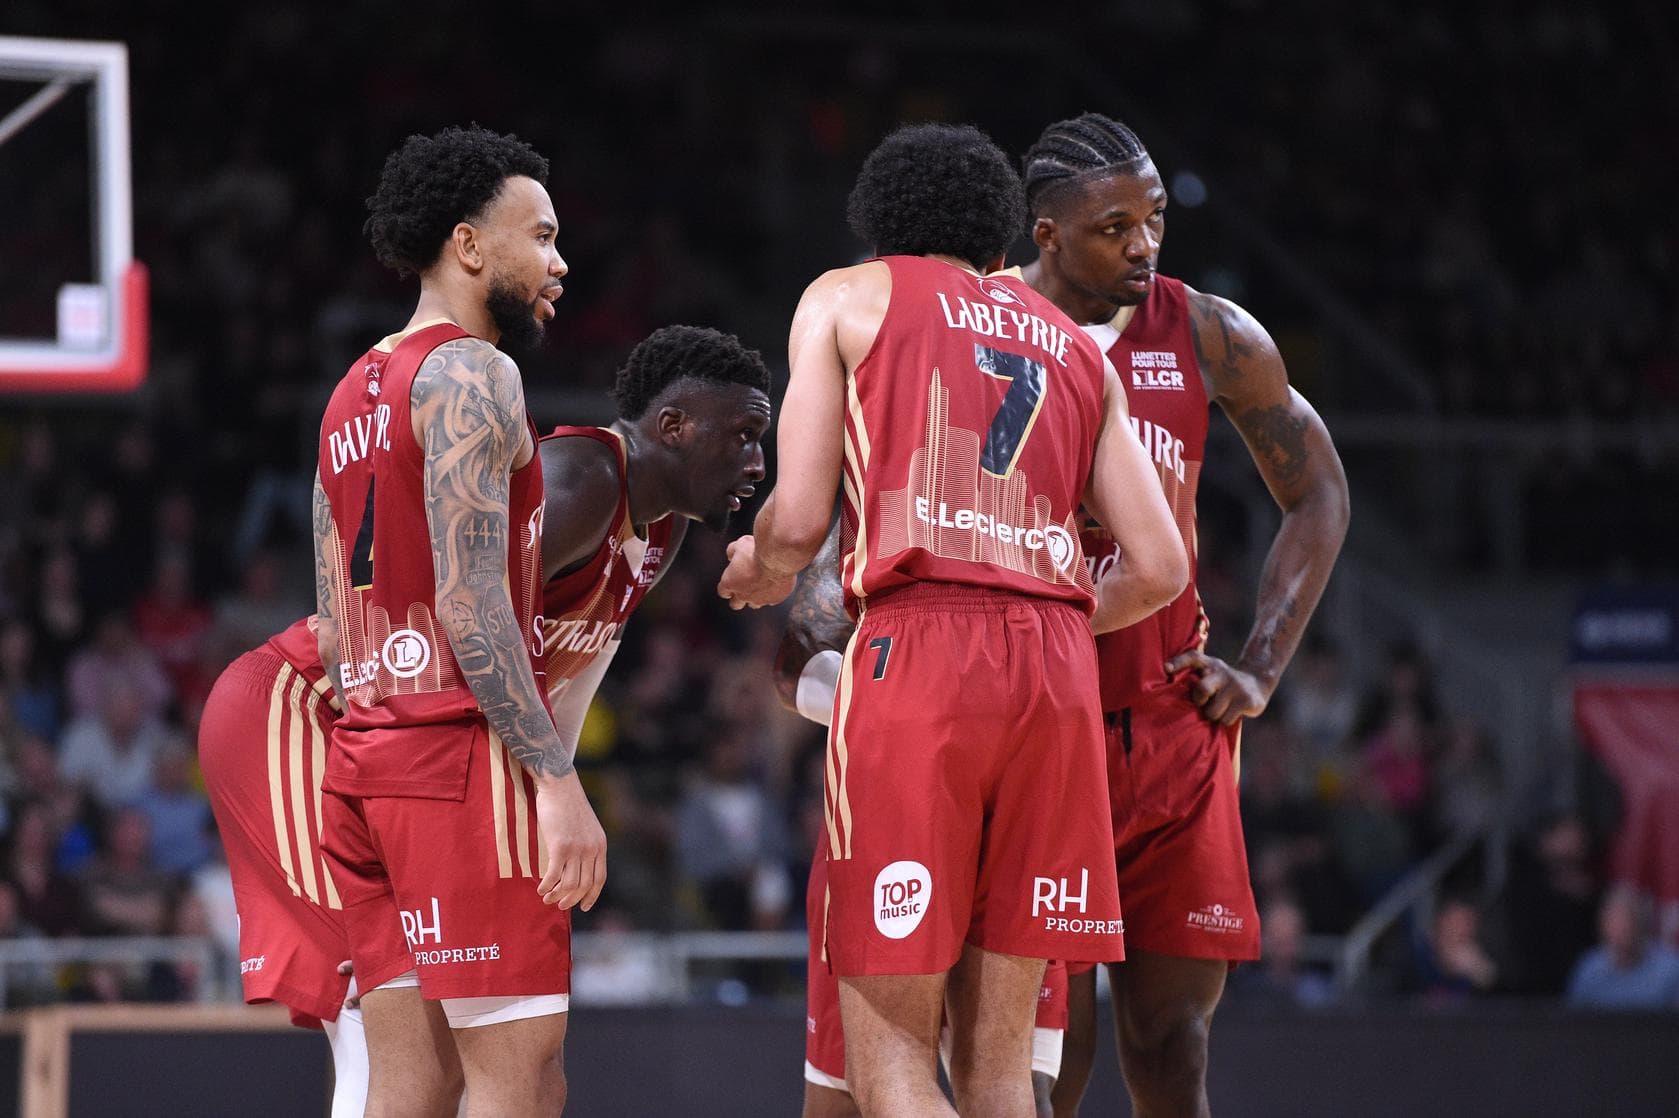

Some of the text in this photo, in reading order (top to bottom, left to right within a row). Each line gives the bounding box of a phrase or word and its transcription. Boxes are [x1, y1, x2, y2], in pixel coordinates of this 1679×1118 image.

[936, 292, 1073, 368] LABEYRIE
[1147, 370, 1184, 387] LCR
[974, 342, 1047, 479] 7
[915, 495, 1044, 550] E.Leclerc
[869, 636, 893, 681] 7
[880, 903, 921, 920] music
[881, 878, 922, 907] TOP
[1032, 867, 1088, 917] RH
[400, 897, 442, 953] RH
[1187, 911, 1244, 930] PRESTIGE
[415, 943, 500, 966] PROPRETÉ
